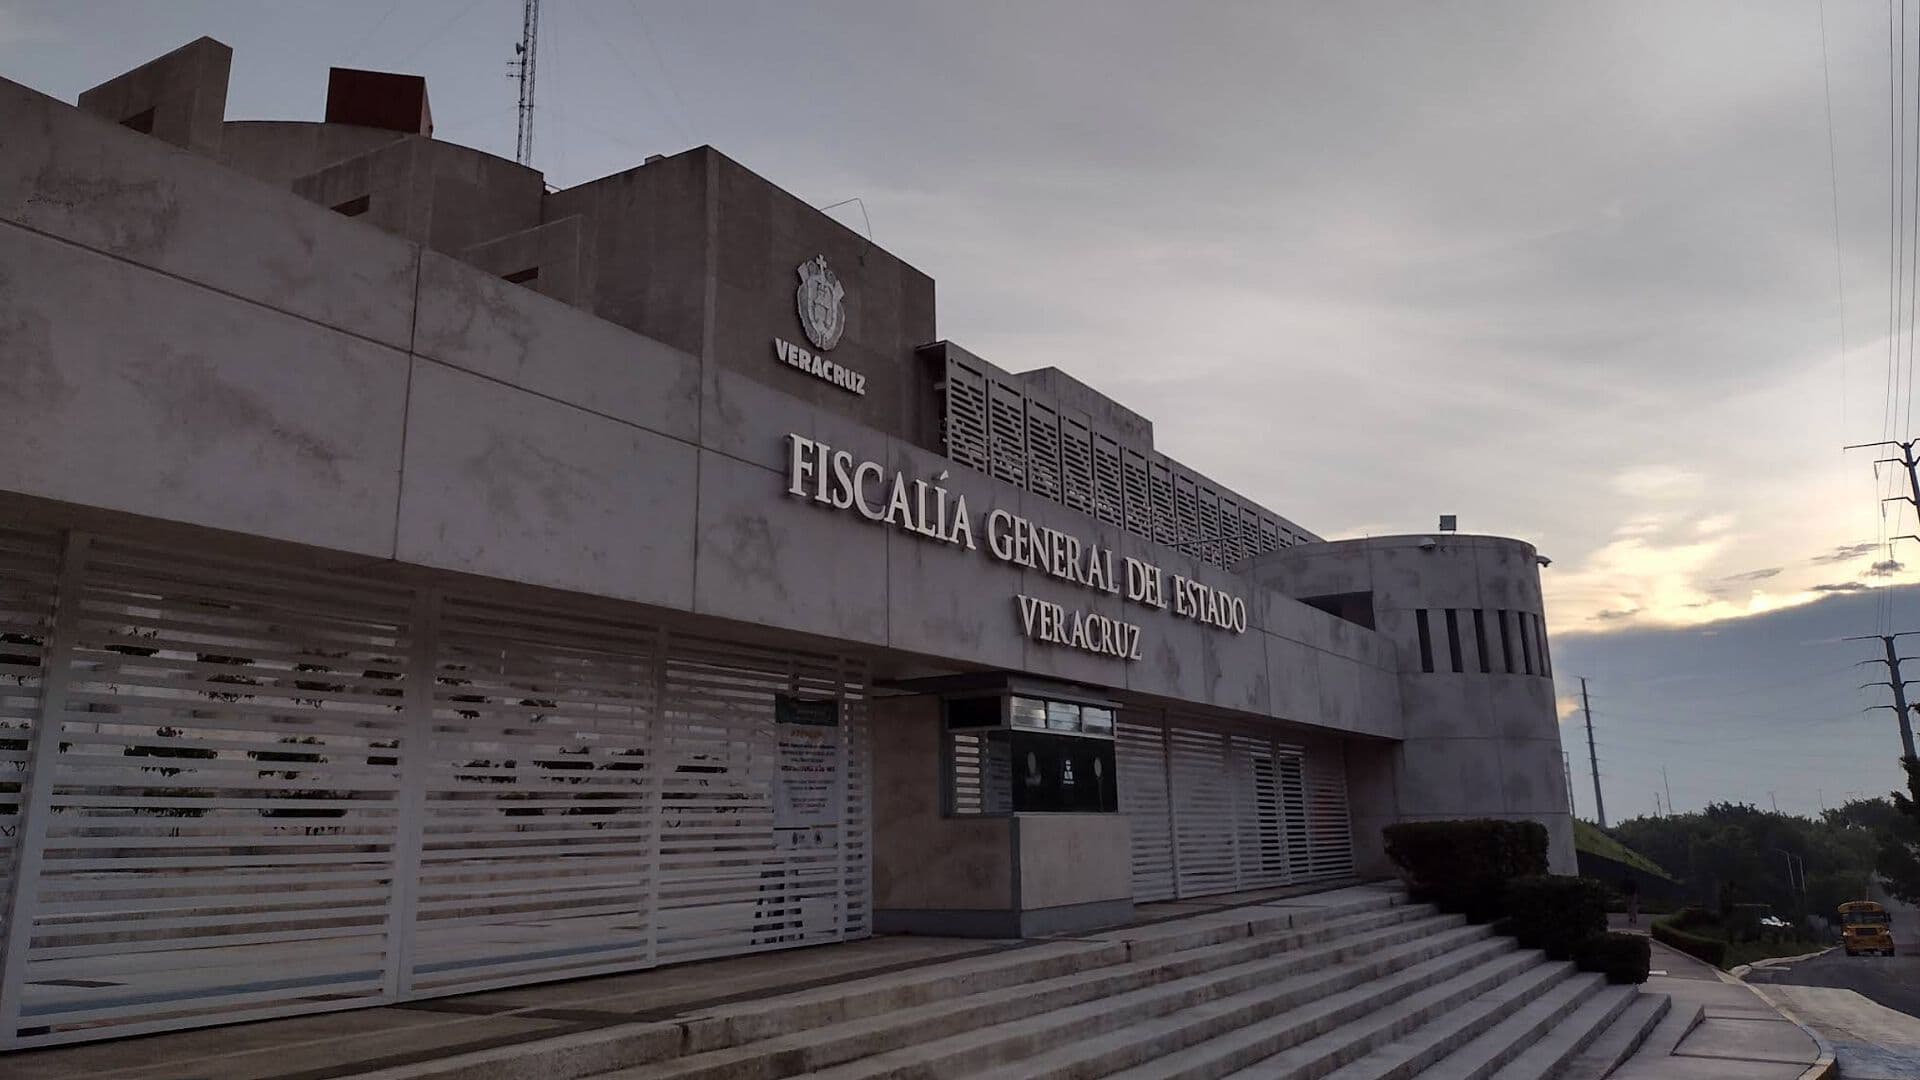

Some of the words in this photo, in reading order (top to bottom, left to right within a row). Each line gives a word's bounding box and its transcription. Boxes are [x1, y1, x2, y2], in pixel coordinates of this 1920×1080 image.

[774, 337, 866, 395] VERACRUZ
[787, 433, 977, 550] FISCALÍA
[987, 508, 1119, 594] GENERAL
[1125, 557, 1168, 609] DEL
[1173, 574, 1248, 634] ESTADO
[1017, 594, 1143, 661] VERACRUZ
